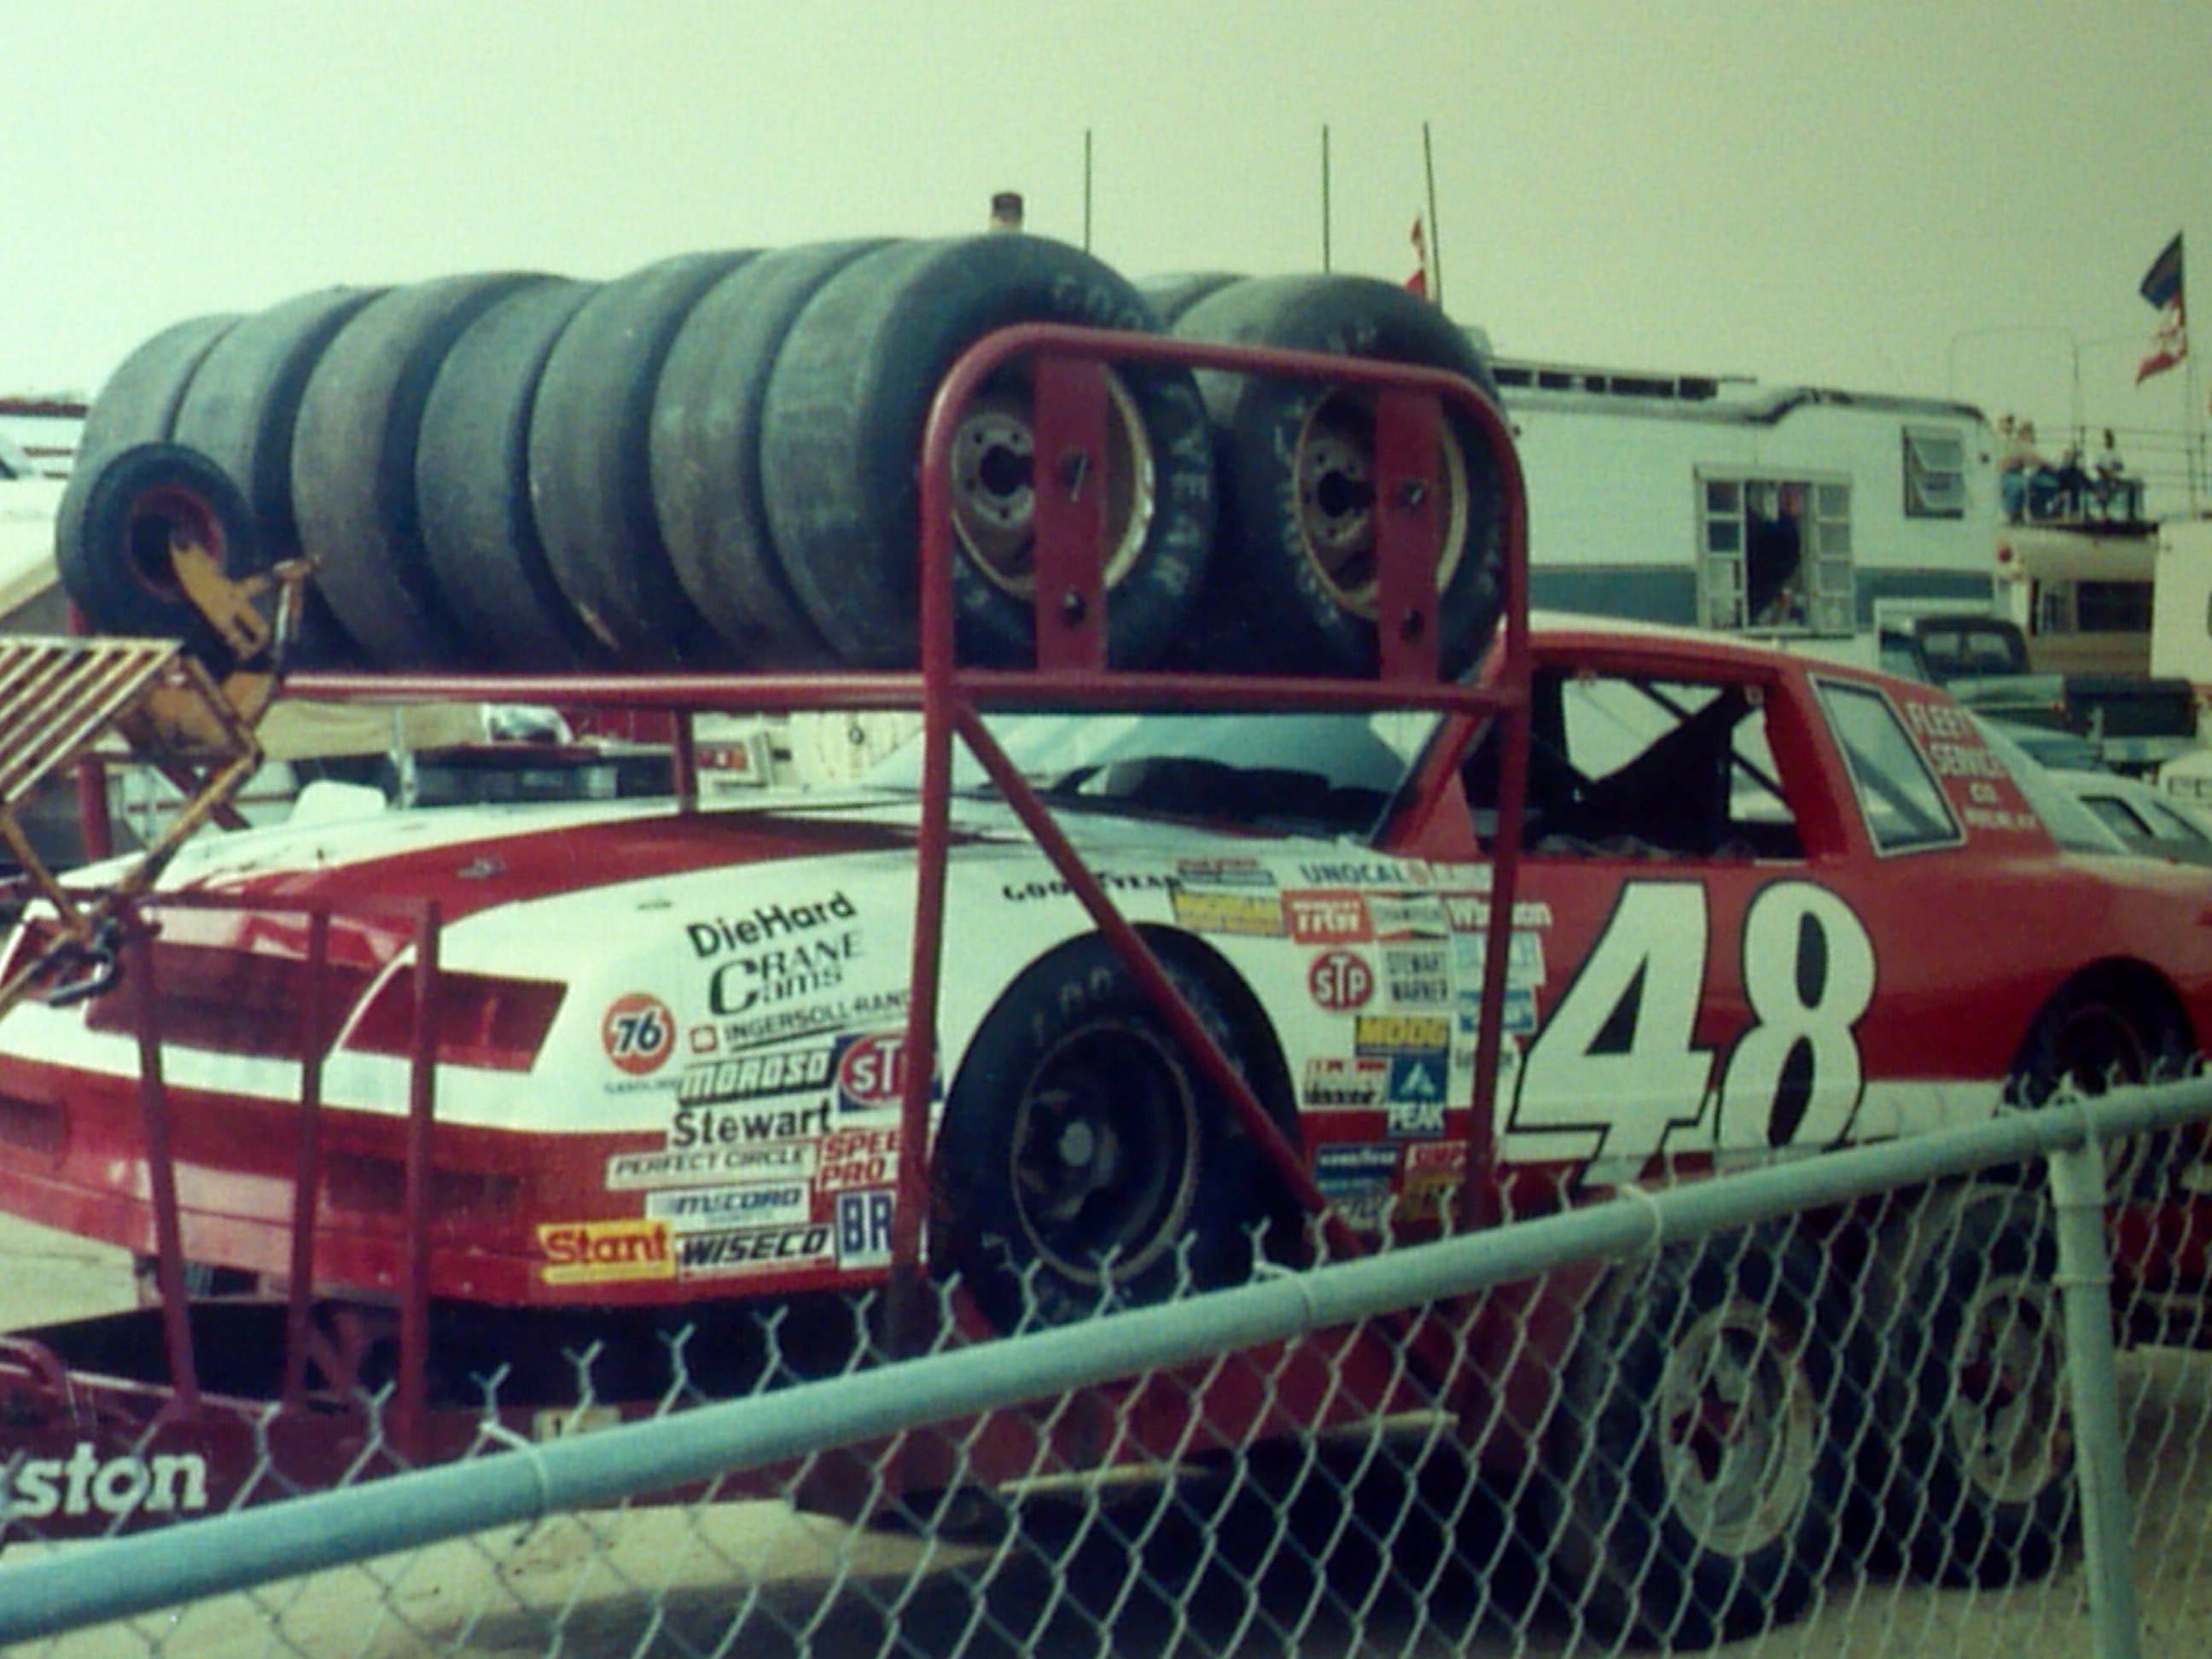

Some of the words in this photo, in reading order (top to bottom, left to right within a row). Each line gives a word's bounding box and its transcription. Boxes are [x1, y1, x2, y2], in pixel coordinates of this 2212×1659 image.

[1001, 873, 1186, 901] GOOYEAR
[1300, 860, 1406, 884] UNOCAL
[685, 889, 858, 958] DieHard
[1291, 899, 1360, 934] TRW
[1312, 955, 1368, 1005] STP
[614, 1010, 663, 1054] 76
[1505, 876, 1877, 1189] 48
[849, 1039, 906, 1093] ST
[672, 1098, 835, 1148] Stewart
[824, 1129, 899, 1159] SPEE
[616, 1150, 719, 1177] PERFECT
[725, 1146, 806, 1170] CIRCLE
[819, 1159, 886, 1188] PRO
[546, 1222, 668, 1265] Stant
[842, 1195, 893, 1253] BR
[684, 1228, 828, 1266] WISECO
[0, 1441, 207, 1517] ston
